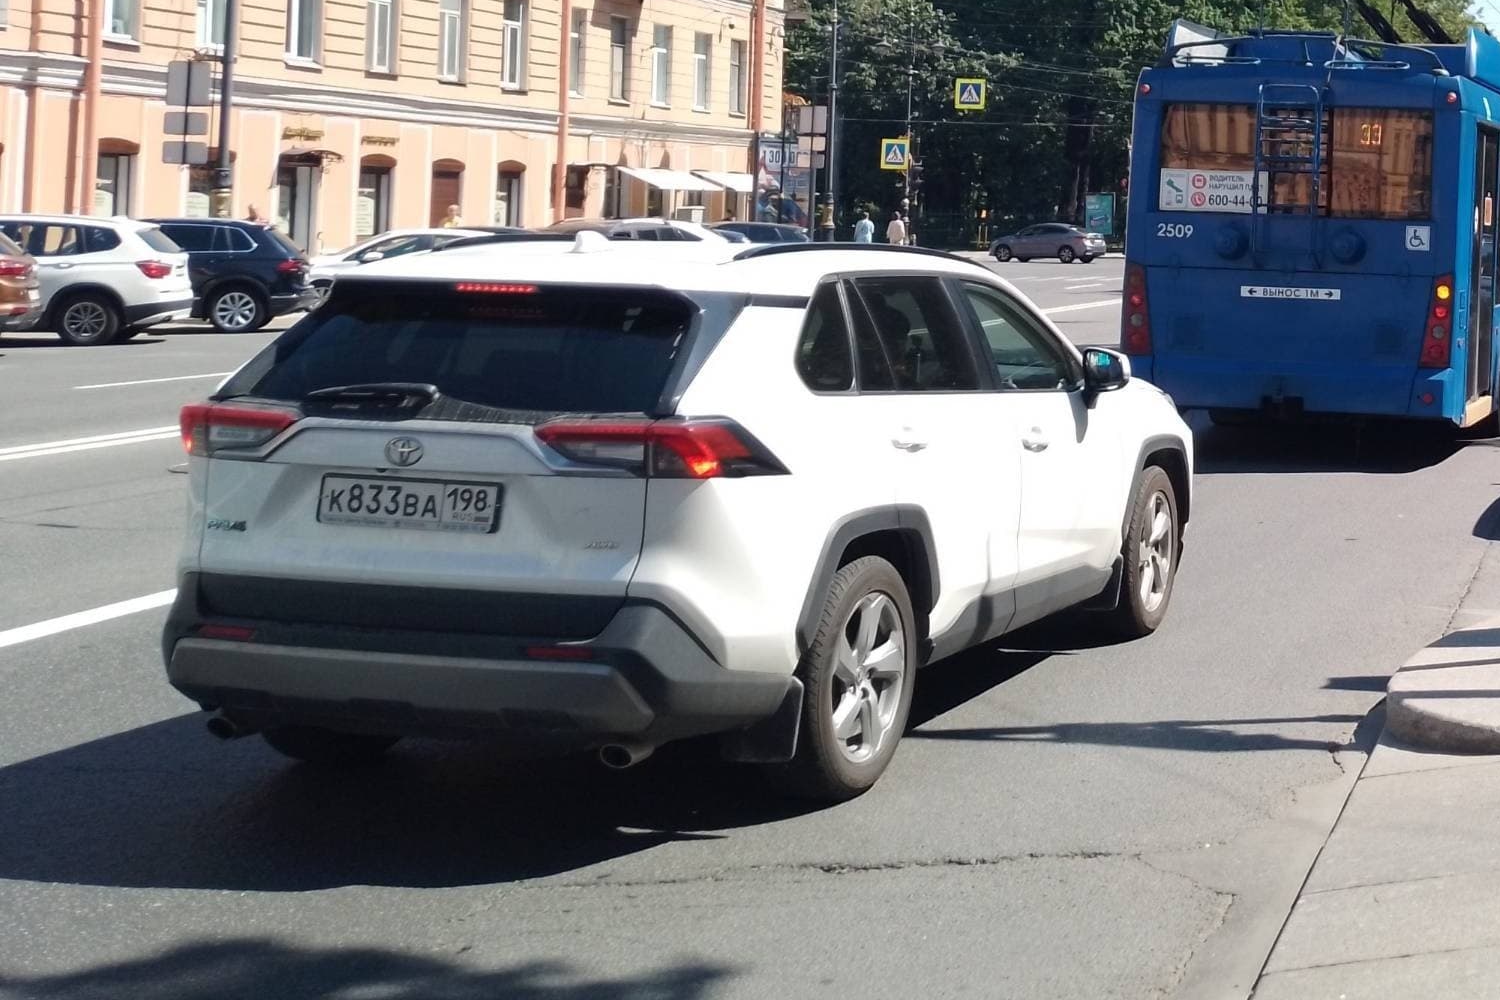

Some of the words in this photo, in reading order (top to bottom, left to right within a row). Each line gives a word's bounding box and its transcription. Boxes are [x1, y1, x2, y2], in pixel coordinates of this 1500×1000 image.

[1157, 222, 1194, 238] 2509
[1262, 287, 1300, 298] ВЫНОС
[328, 483, 437, 518] К833ВА
[447, 487, 489, 512] 198
[452, 512, 473, 521] RUS
